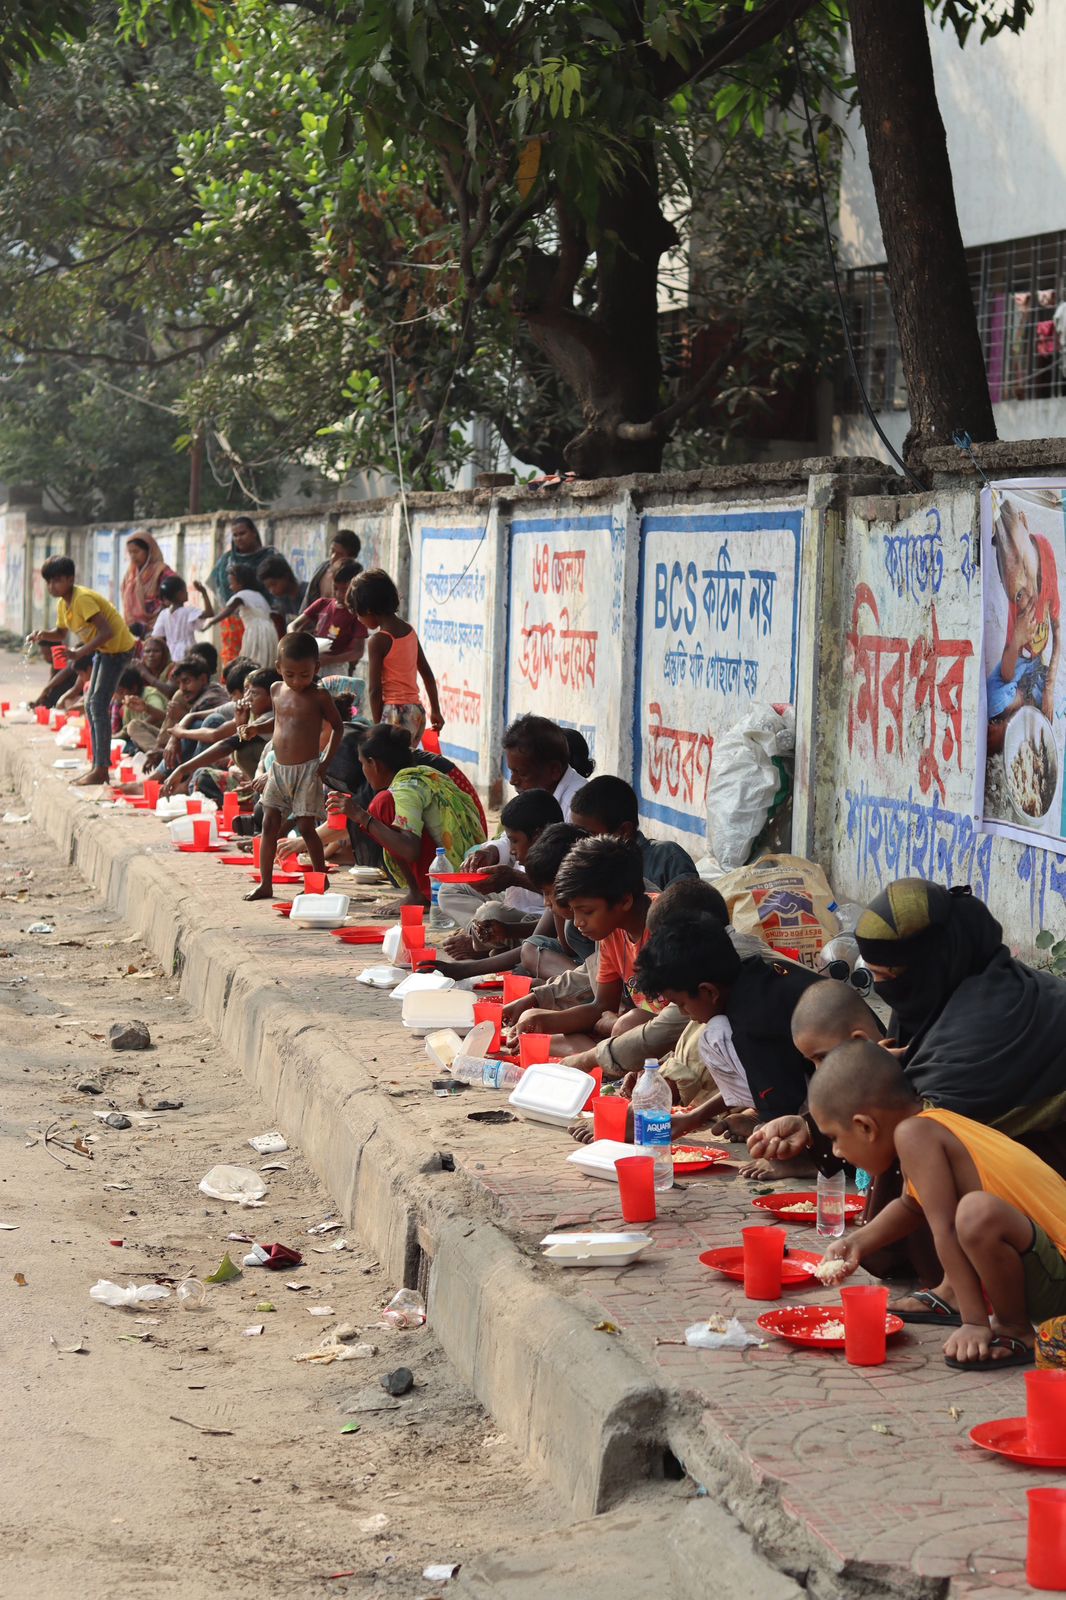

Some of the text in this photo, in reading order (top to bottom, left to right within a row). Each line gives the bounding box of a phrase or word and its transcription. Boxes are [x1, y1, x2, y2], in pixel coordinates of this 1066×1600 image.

[655, 560, 697, 636] BCS
[702, 538, 746, 640] কঠিন
[748, 569, 777, 640] নয়
[883, 507, 944, 605] ক্যাডেট
[664, 639, 759, 698] প্রস্তুতি যদি গোছানো হয়
[846, 582, 974, 806] মিরপুর
[648, 702, 714, 809] উত্তরণ
[789, 929, 804, 937] FOR
[804, 928, 823, 936] BEST
